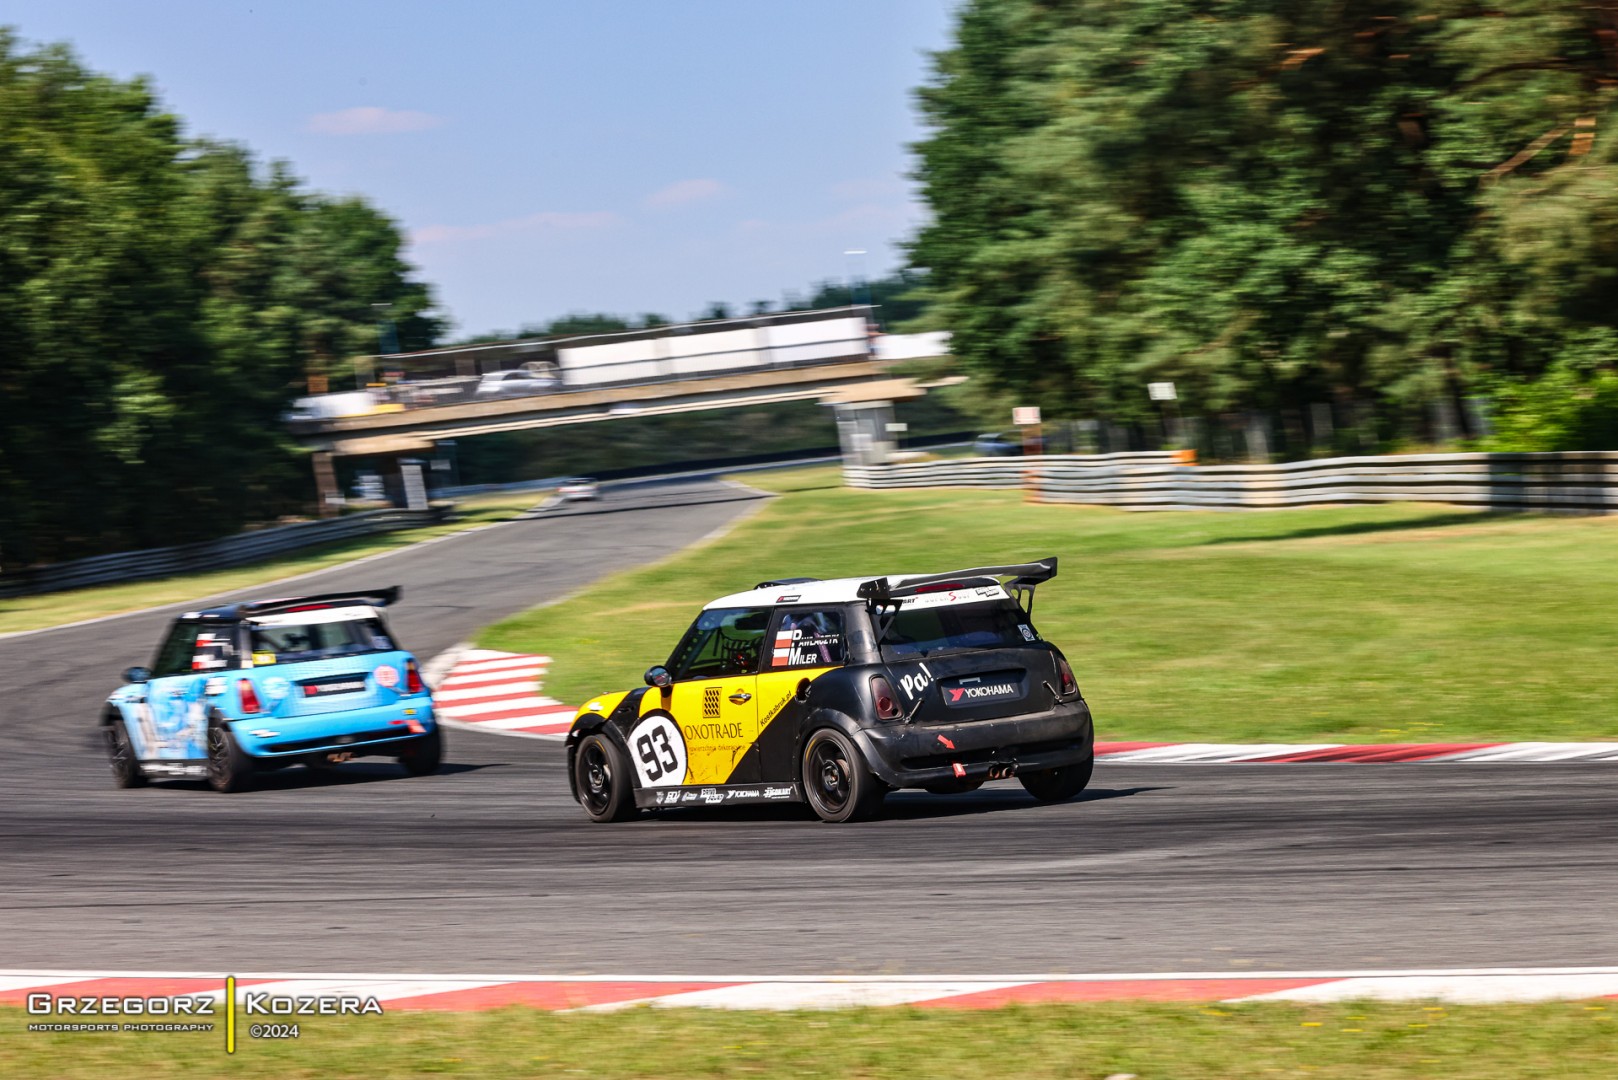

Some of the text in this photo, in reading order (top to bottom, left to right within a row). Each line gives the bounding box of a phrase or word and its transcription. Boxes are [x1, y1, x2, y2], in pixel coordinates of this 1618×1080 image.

[788, 647, 818, 666] MILER
[965, 684, 1014, 698] YOKOHAMA
[684, 722, 744, 740] OXOTRADE
[636, 725, 678, 782] 93
